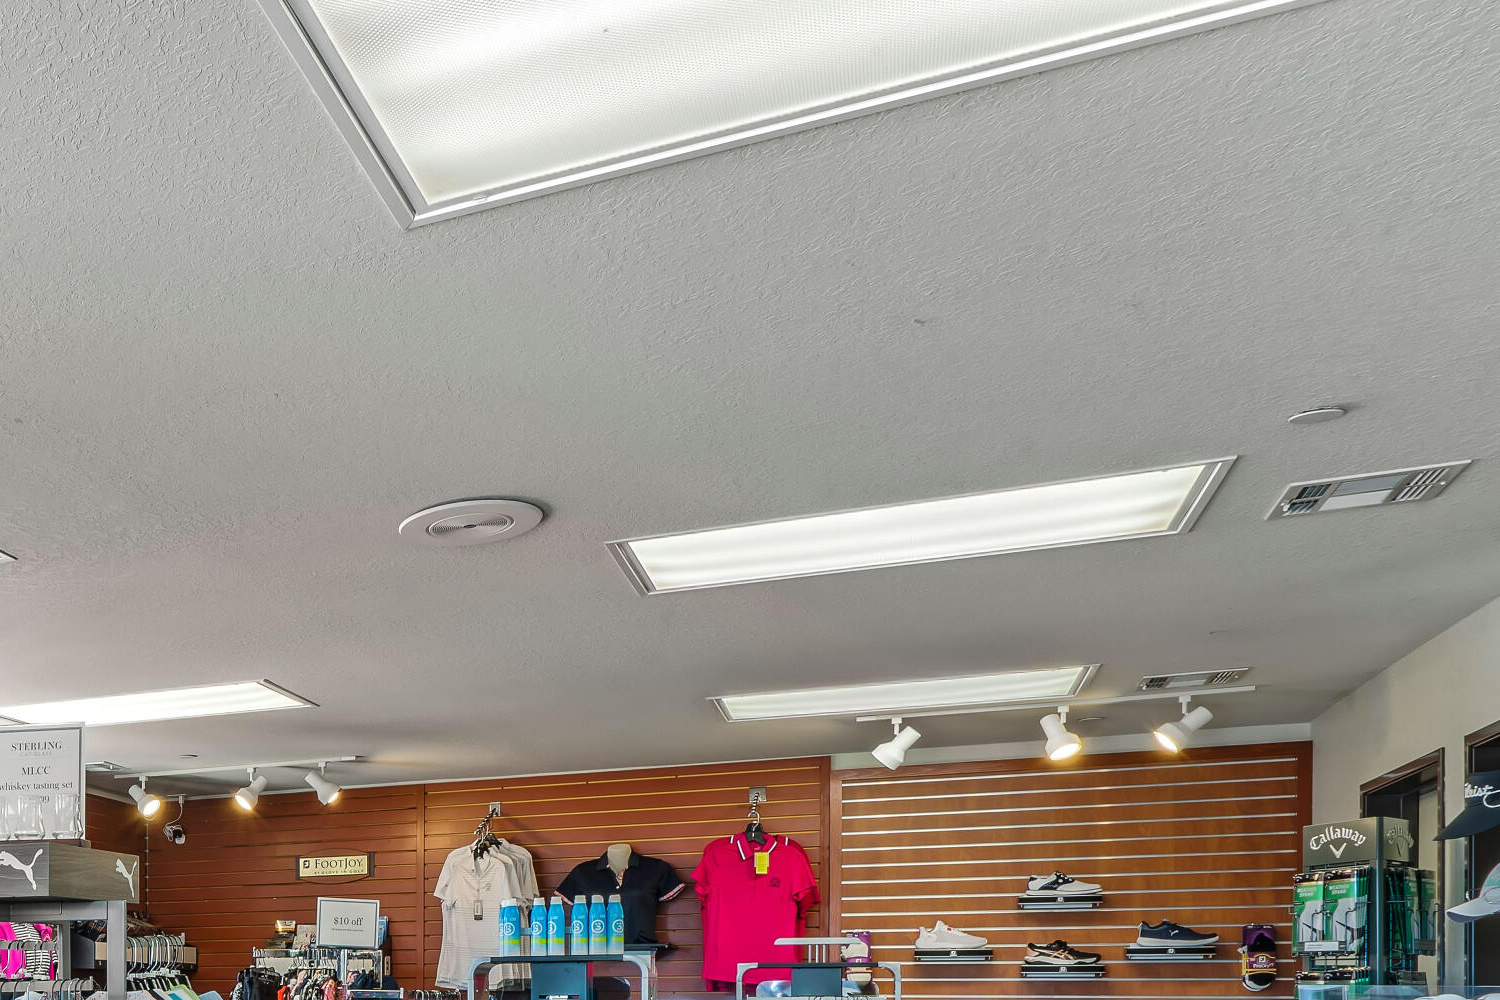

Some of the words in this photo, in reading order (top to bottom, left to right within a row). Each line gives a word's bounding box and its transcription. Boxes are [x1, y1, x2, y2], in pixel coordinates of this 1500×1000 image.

[11, 741, 62, 752] STERLING
[21, 766, 51, 775] MLCC
[33, 781, 59, 790] tasting
[61, 781, 73, 789] set
[1309, 825, 1367, 851] Callaway
[333, 916, 349, 926] $10
[351, 917, 364, 926] off
